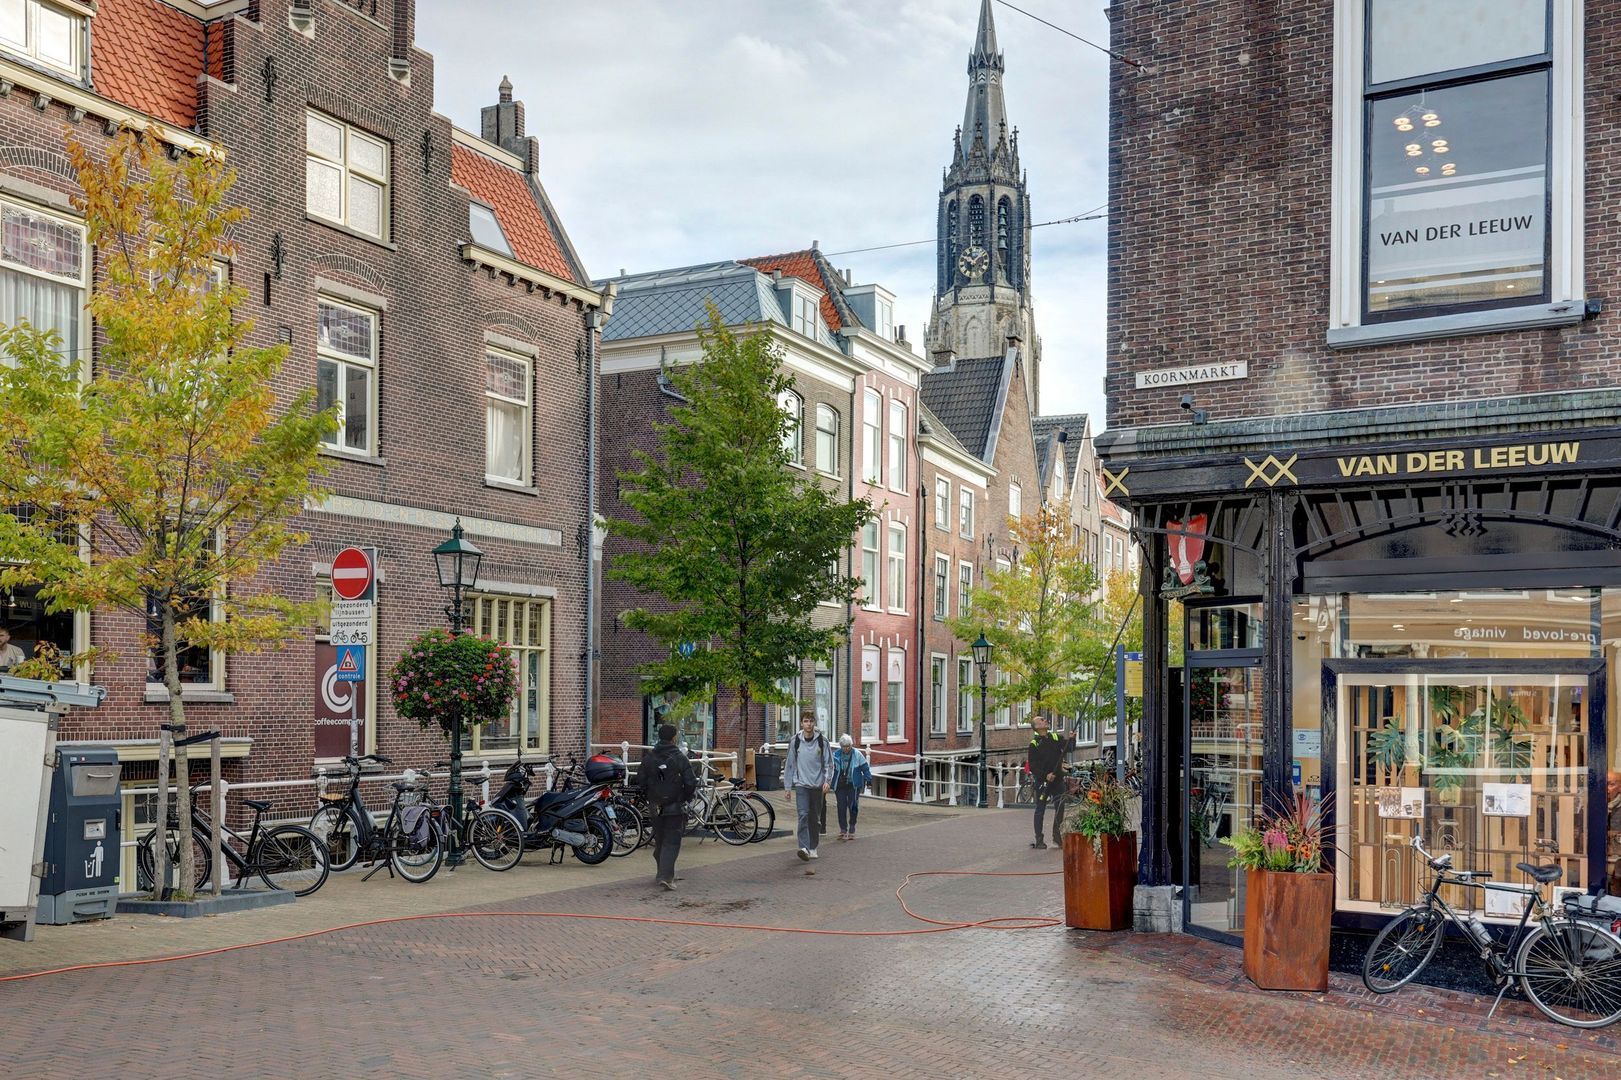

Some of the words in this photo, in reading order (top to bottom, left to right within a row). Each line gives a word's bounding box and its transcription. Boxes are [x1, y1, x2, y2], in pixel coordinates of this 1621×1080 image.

[1380, 228, 1419, 247] VAN
[1426, 223, 1462, 242] DER
[1469, 214, 1533, 237] LEEUW
[1144, 365, 1239, 385] KOORNMARKT
[1337, 454, 1398, 477] VAN
[1406, 450, 1465, 474] DER
[1474, 442, 1580, 470] LEEUW
